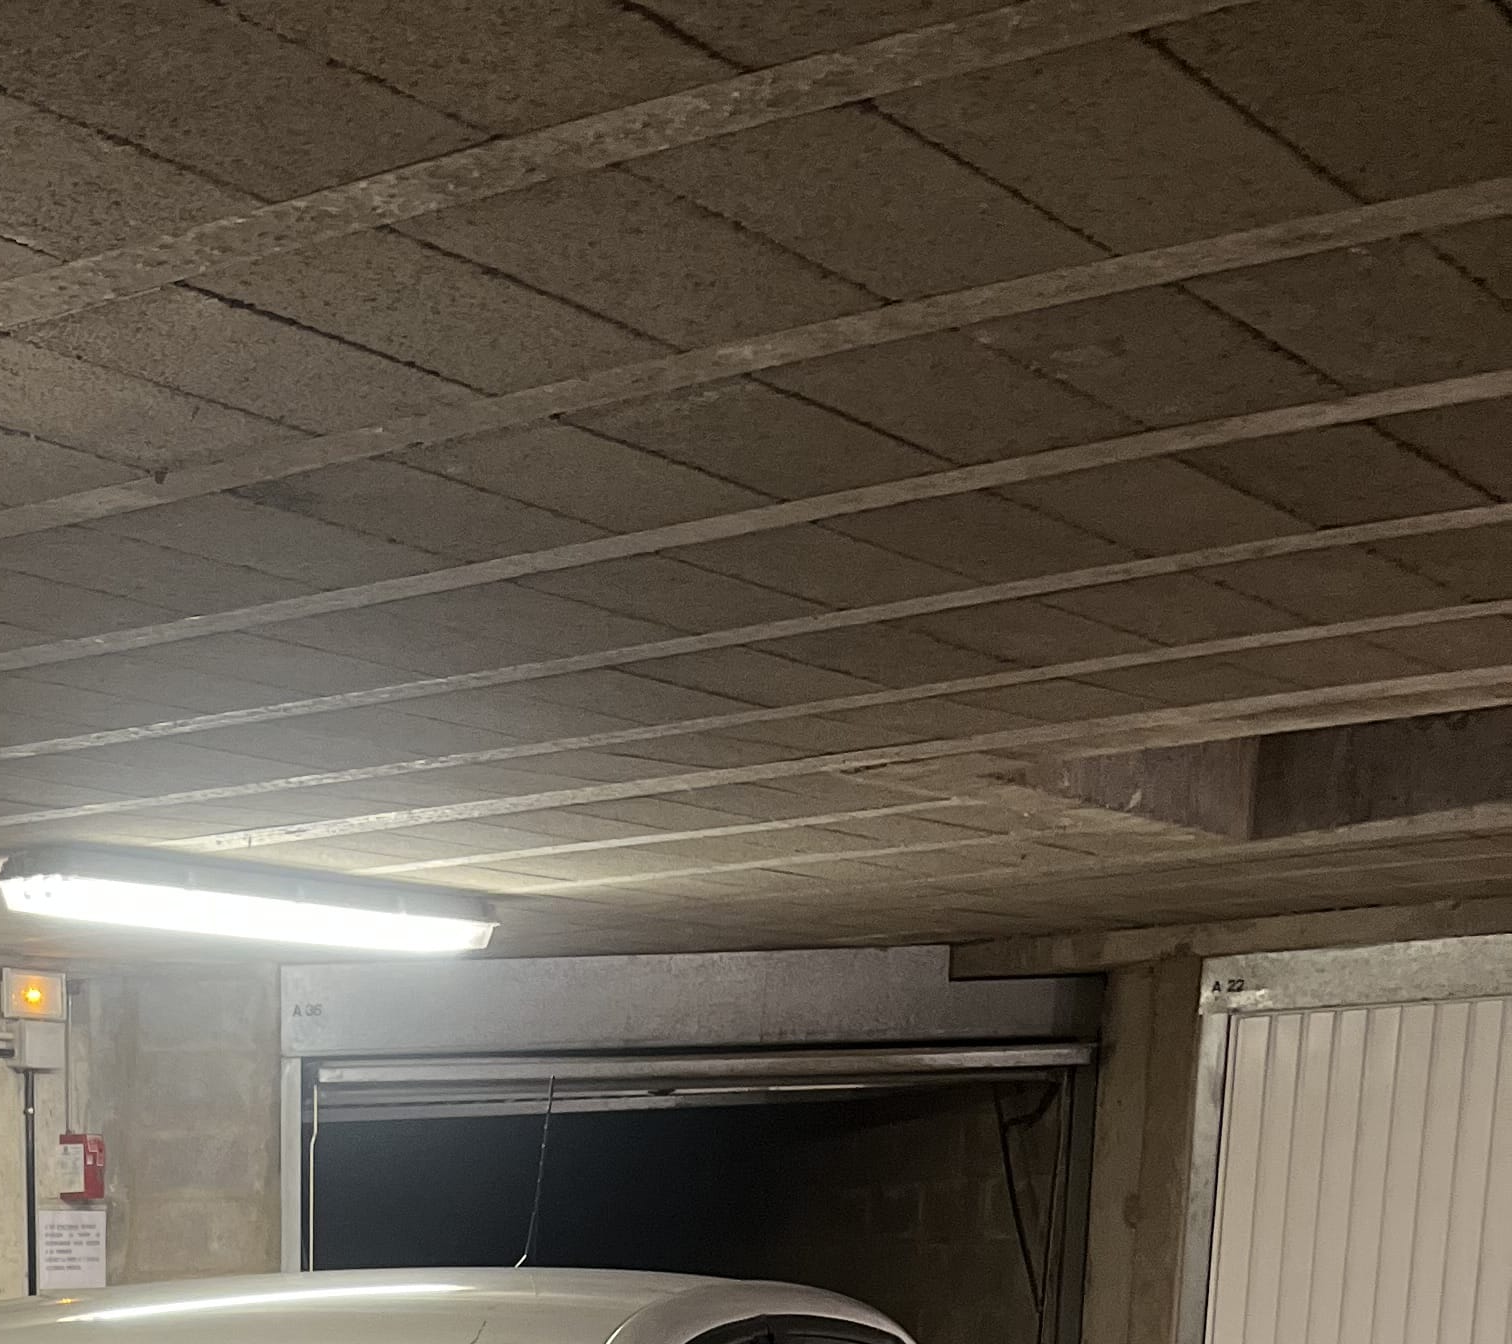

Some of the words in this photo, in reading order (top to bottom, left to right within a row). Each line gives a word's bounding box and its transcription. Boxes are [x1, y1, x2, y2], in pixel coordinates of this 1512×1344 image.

[1211, 980, 1222, 992] A
[1227, 978, 1245, 993] 22
[292, 1003, 302, 1017] A
